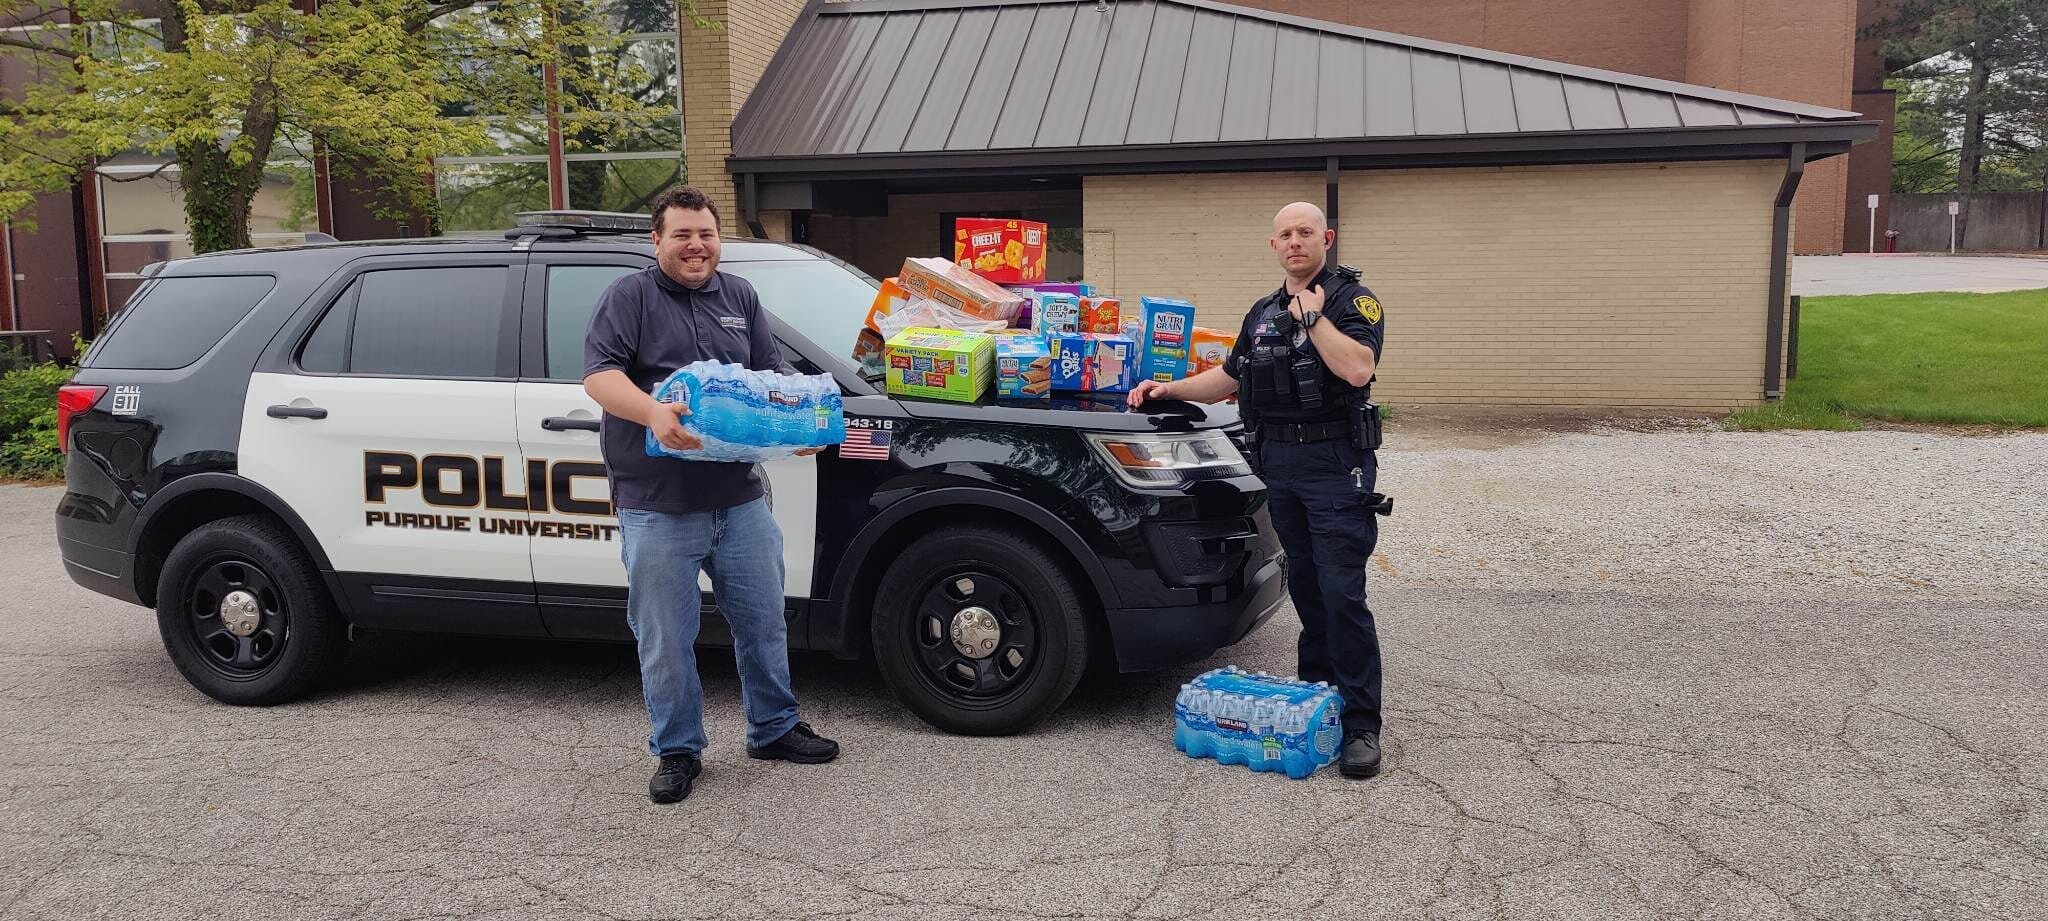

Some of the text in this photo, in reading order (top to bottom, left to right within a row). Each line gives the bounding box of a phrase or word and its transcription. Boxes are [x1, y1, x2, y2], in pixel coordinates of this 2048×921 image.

[1006, 221, 1018, 229] 45
[972, 231, 1002, 247] CHEEZ-IT
[1157, 315, 1183, 324] NUTRI
[1156, 322, 1182, 331] GRAIN
[115, 385, 141, 393] CALL
[114, 395, 138, 410] 911
[363, 449, 617, 518] POLIC
[365, 511, 620, 541] PURDUE UNIVERSIT
